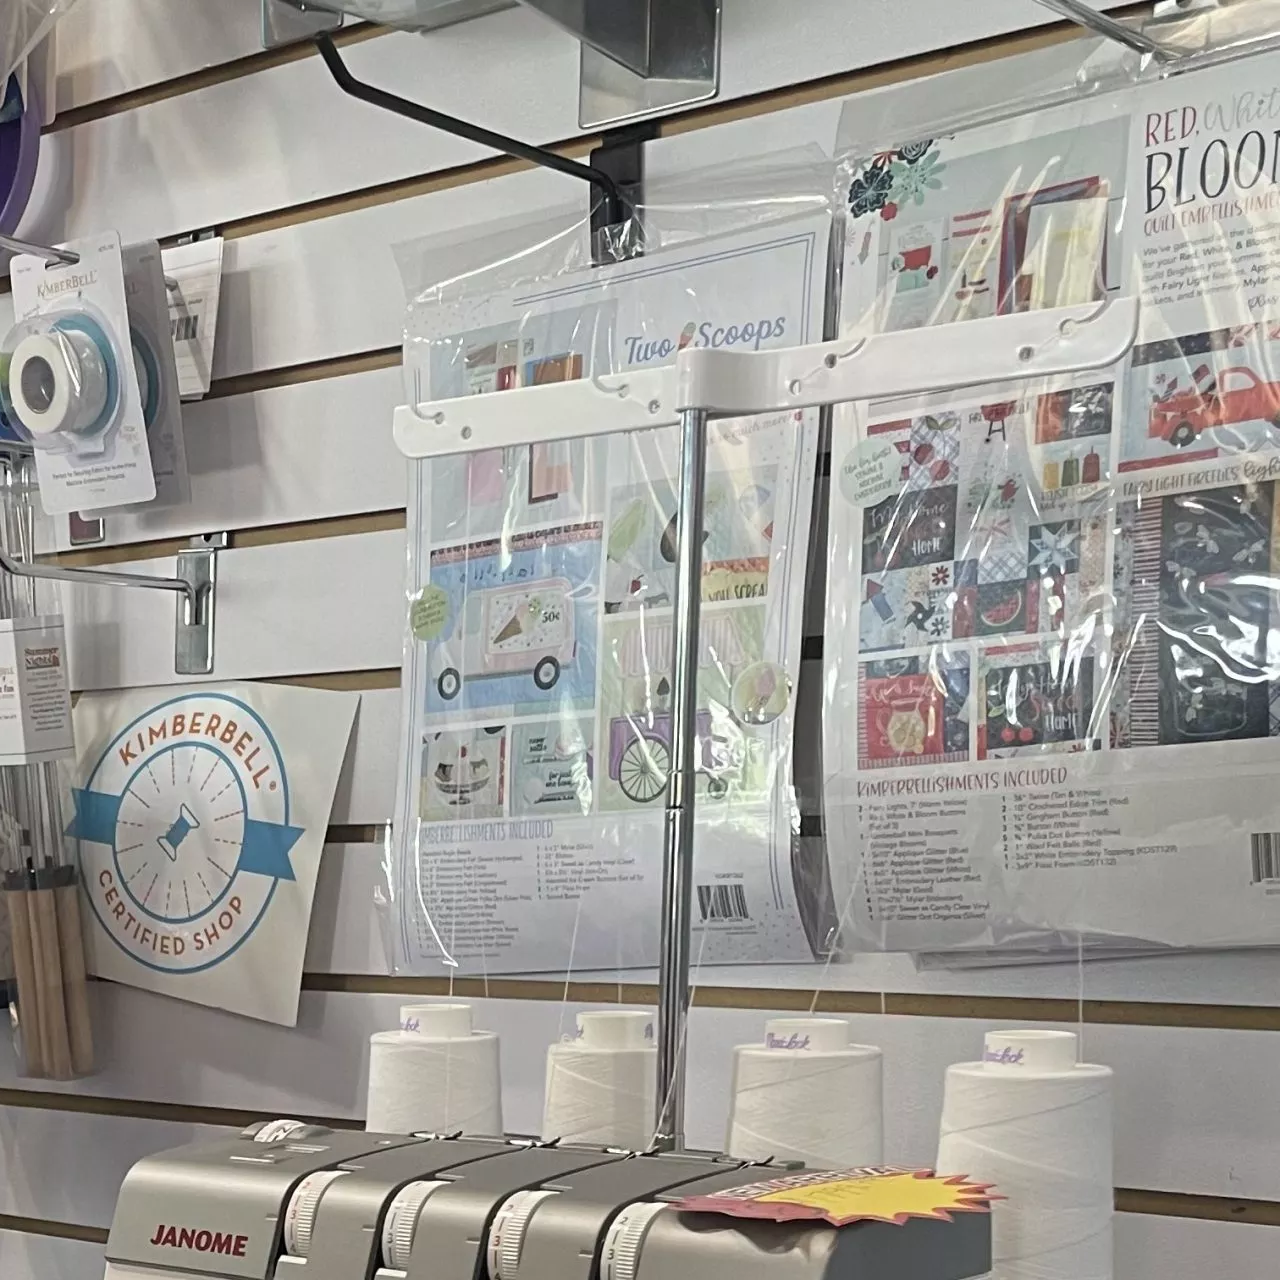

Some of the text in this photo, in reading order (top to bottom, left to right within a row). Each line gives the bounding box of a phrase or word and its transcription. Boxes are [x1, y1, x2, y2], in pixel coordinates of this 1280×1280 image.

[1145, 130, 1280, 214] BLOO
[1161, 280, 1184, 290] Fairy
[625, 316, 786, 364] Two Scoops
[1155, 472, 1185, 492] LIGHT
[119, 712, 270, 789] KIMBERBELL
[1004, 766, 1067, 787] INCLUDED
[99, 869, 242, 956] CERTIFIED SHOP
[290, 1209, 298, 1220] 3
[620, 1216, 628, 1225] 2
[150, 1225, 249, 1257] JANOME
[493, 1235, 500, 1246] 3
[607, 1249, 615, 1260] 3
